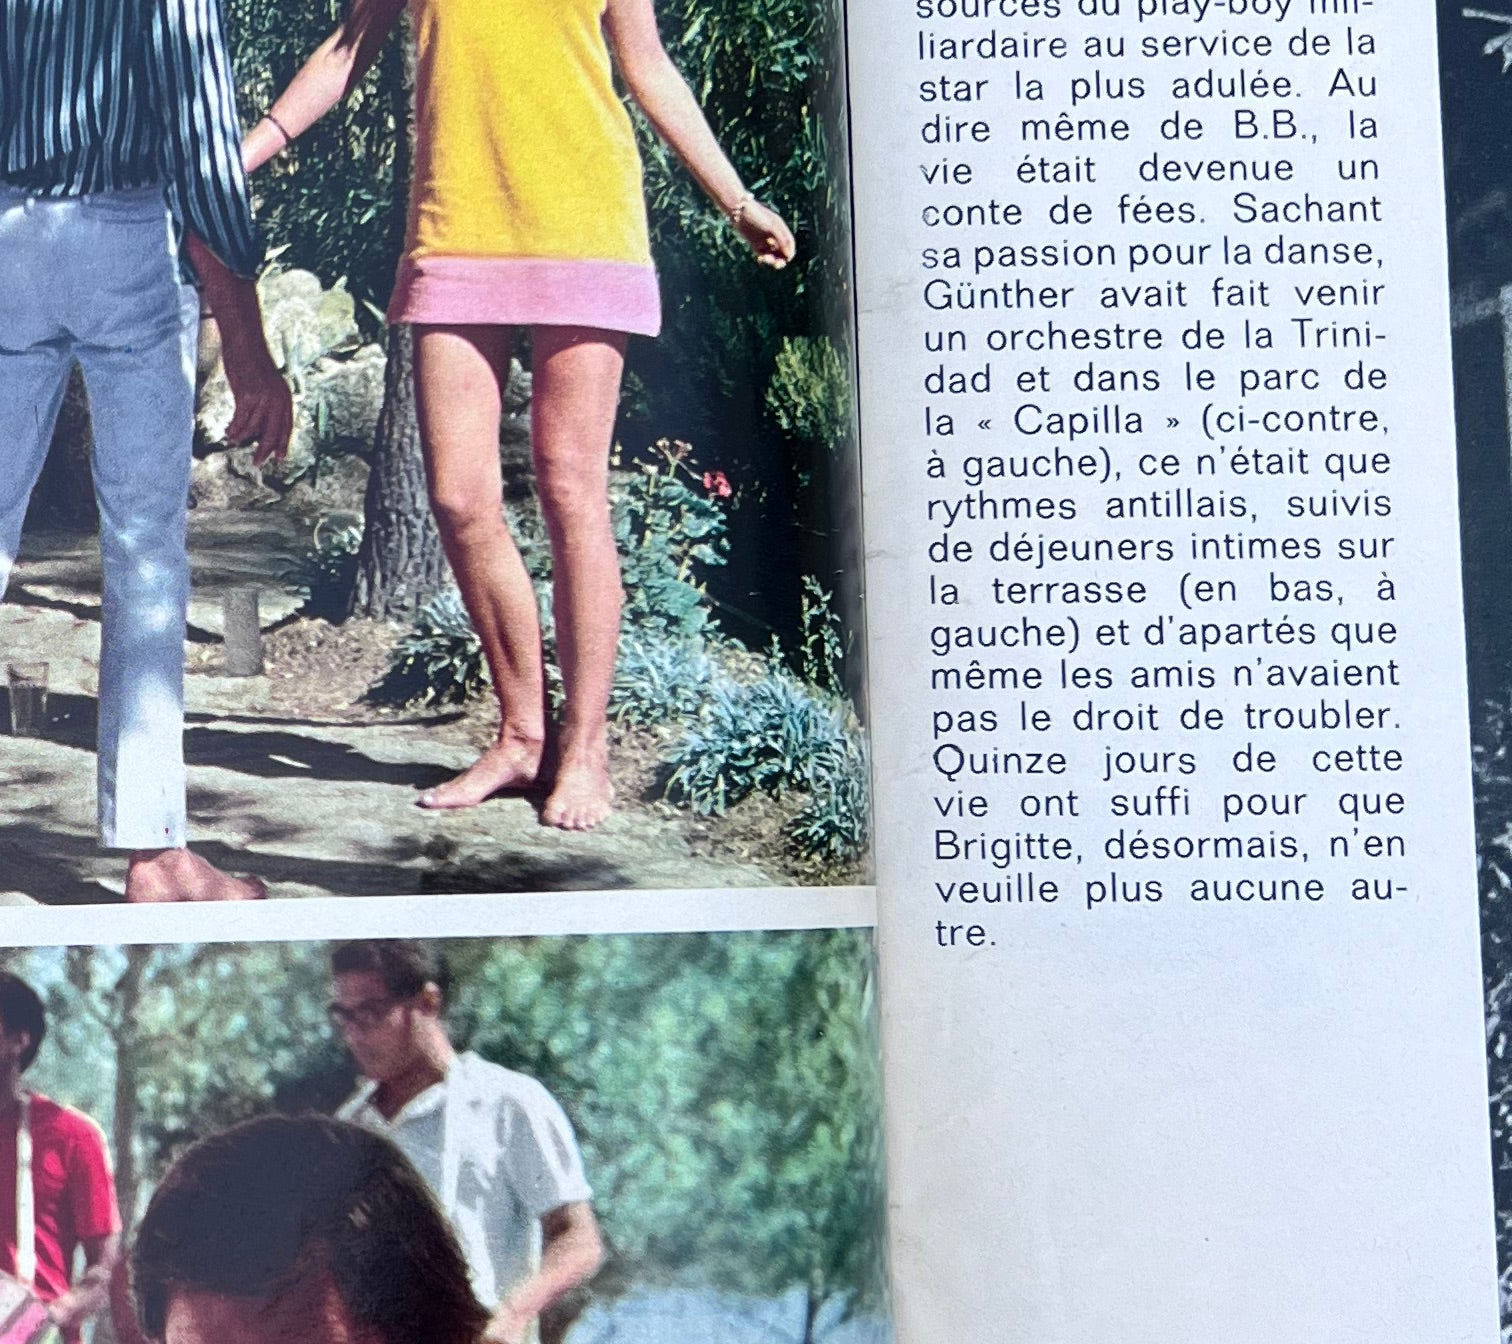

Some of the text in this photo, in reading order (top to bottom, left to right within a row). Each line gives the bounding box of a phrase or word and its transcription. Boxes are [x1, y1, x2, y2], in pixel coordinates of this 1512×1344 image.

[918, 25, 1376, 61] liardaire au service de la
[919, 66, 1377, 107] star la plus adulée. Au
[921, 108, 1378, 145] dire même de B.B., la
[919, 151, 1379, 185] vie était devenue un
[921, 191, 1383, 228] conte de fées. Sachant
[921, 233, 1383, 276] sa passion pour la danse,
[923, 276, 1386, 311] Günther avait fait venir
[924, 317, 1387, 353] un orchestre de la Trini-
[924, 359, 1388, 398] dad et dans le parc de
[925, 405, 955, 437] la
[1013, 403, 1144, 442] Capilla
[1201, 402, 1389, 441] (ci-contre,
[926, 444, 1391, 487] à gauche), ce n’était que
[927, 487, 1392, 529] rythmes antillais, suivis
[927, 530, 1395, 570] de déjeuners intimes sur
[929, 570, 1397, 611] la terrasse (en bas, à
[930, 613, 1398, 657] gauche) et d’apartés que
[931, 656, 1401, 690] même les amis n’avaient
[933, 698, 1400, 741] pas le droit de troubler.
[932, 741, 1403, 783] Quinze jours de cette
[933, 784, 1405, 824] vie ont suffi pour que
[934, 826, 1406, 870] Brigitte, désormais, n’en
[934, 871, 1408, 911] veuille plus aucune au-
[934, 919, 997, 948] tre.
